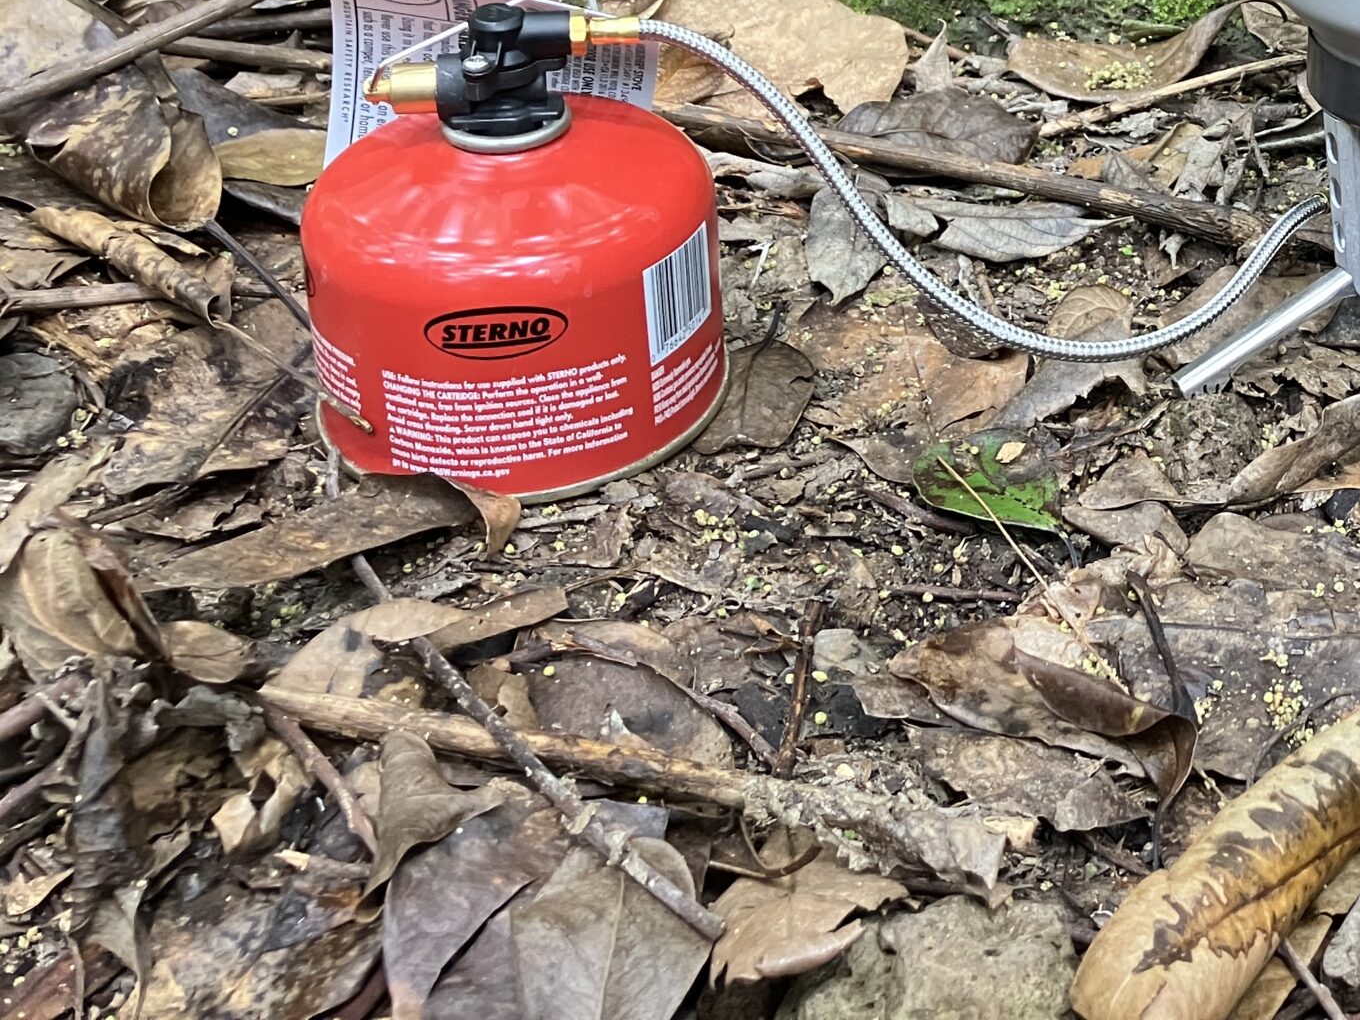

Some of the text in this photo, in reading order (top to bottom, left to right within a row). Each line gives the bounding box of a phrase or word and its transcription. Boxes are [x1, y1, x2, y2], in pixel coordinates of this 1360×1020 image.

[343, 39, 353, 68] SAFETY
[583, 63, 595, 75] USE
[631, 71, 644, 91] STOVE
[581, 76, 594, 95] ONLY
[442, 317, 551, 343] STERNO
[464, 381, 475, 389] for
[528, 373, 545, 383] with
[547, 368, 578, 380] STERNO
[579, 361, 609, 376] products
[481, 390, 514, 399] Perform
[516, 387, 529, 395] the
[530, 381, 568, 395] operation
[539, 394, 560, 402] Close
[561, 390, 574, 399] the
[575, 382, 610, 398] appliance
[611, 377, 628, 387] from
[461, 413, 473, 421] the
[517, 408, 534, 417] seal
[558, 396, 594, 410] damaged
[595, 395, 604, 403] or
[435, 434, 452, 443] This
[452, 435, 484, 445] product
[501, 430, 531, 441] expose
[533, 428, 548, 438] you
[560, 417, 599, 432] chemicals
[600, 407, 634, 423] including
[489, 422, 511, 431] down
[513, 419, 534, 428] hand
[535, 415, 553, 426] tight
[429, 456, 459, 466] defects
[460, 458, 469, 466] or
[470, 454, 521, 467] reproductive
[522, 451, 547, 461] harm.
[548, 448, 562, 456] For
[563, 444, 583, 454] more
[584, 432, 628, 449] information
[455, 447, 480, 455] which
[481, 446, 489, 454] is
[490, 445, 517, 453] known
[519, 442, 527, 450] to
[528, 439, 542, 448] the
[543, 436, 565, 446] State
[576, 427, 613, 440] California
[614, 422, 622, 430] to
